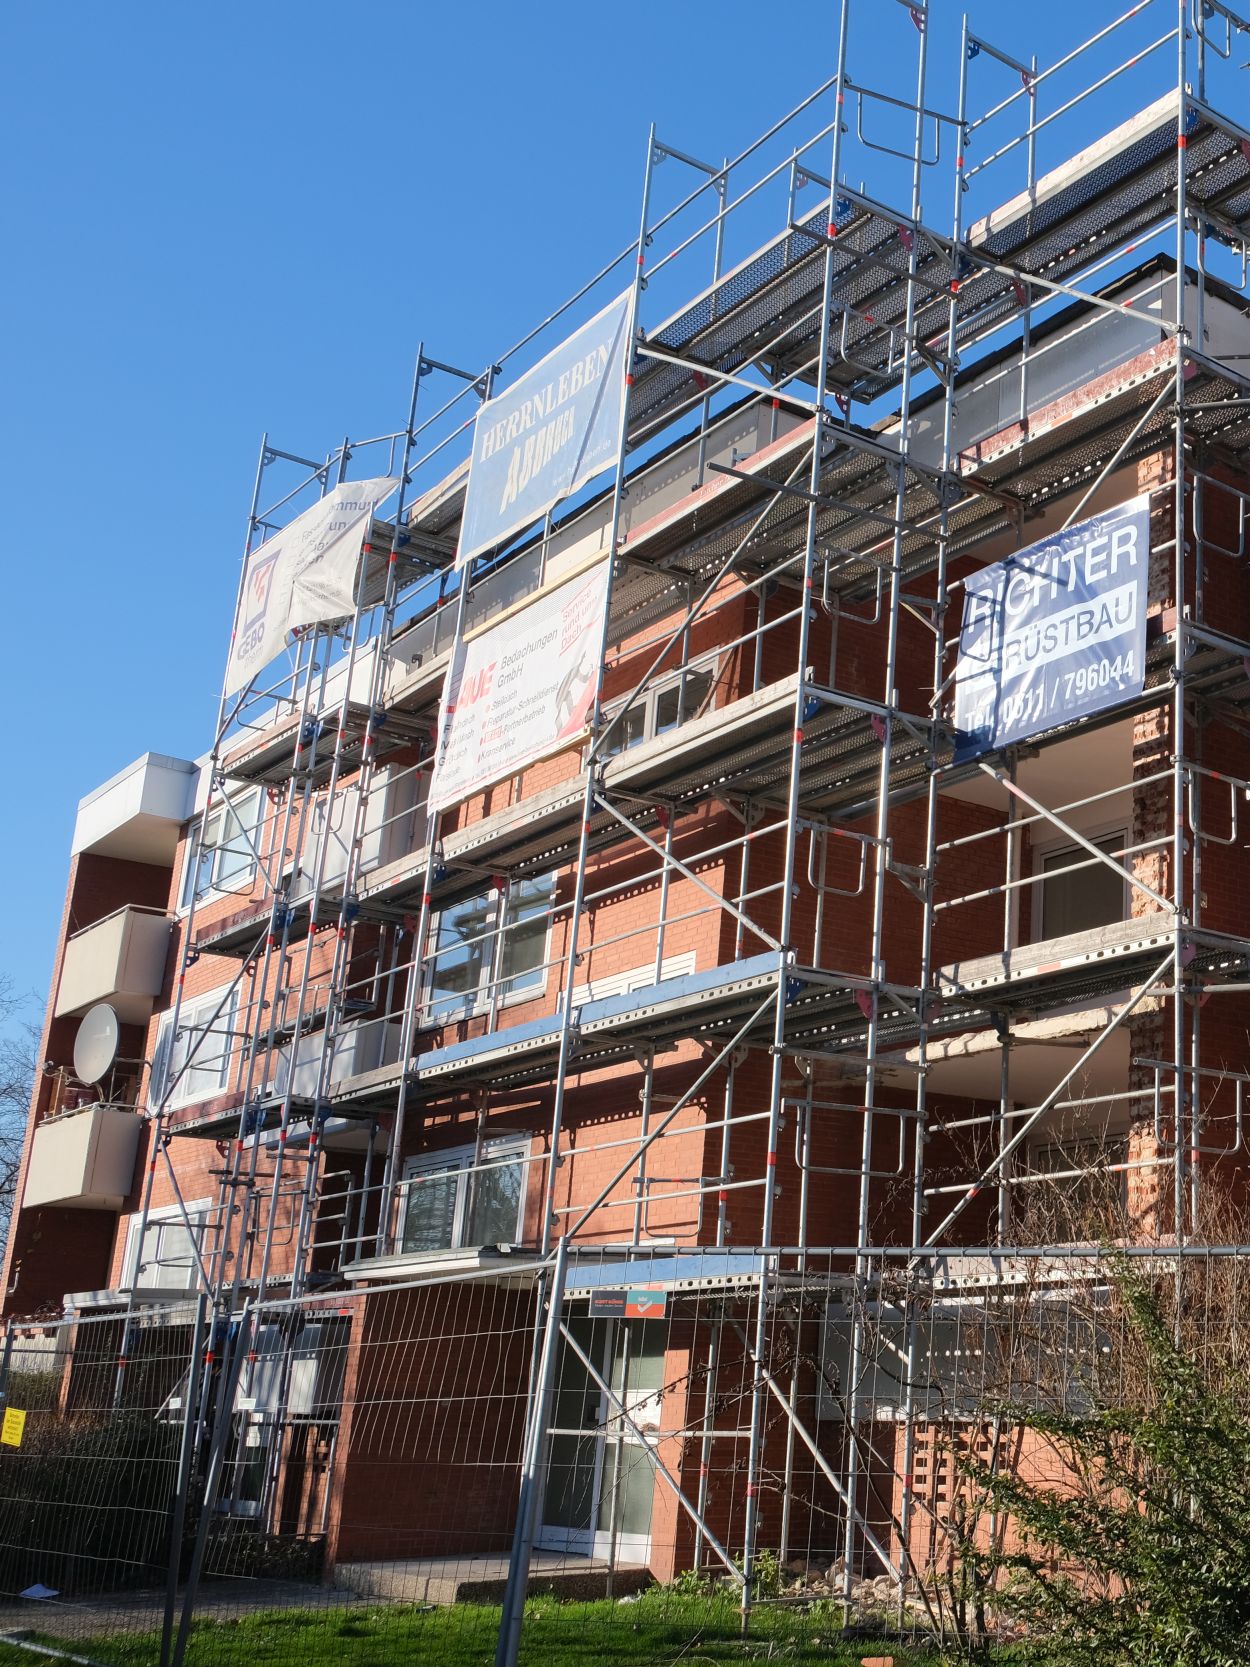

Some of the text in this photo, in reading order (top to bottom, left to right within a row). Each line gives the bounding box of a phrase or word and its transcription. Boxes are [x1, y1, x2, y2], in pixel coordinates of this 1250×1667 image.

[480, 337, 614, 464] HERRNLEBEN
[968, 524, 1139, 635] RICHTER
[501, 629, 559, 670] Bedachungen
[969, 590, 1133, 684] RÜSTBAU
[497, 663, 524, 689] GmbH
[1063, 650, 1135, 700] 796044
